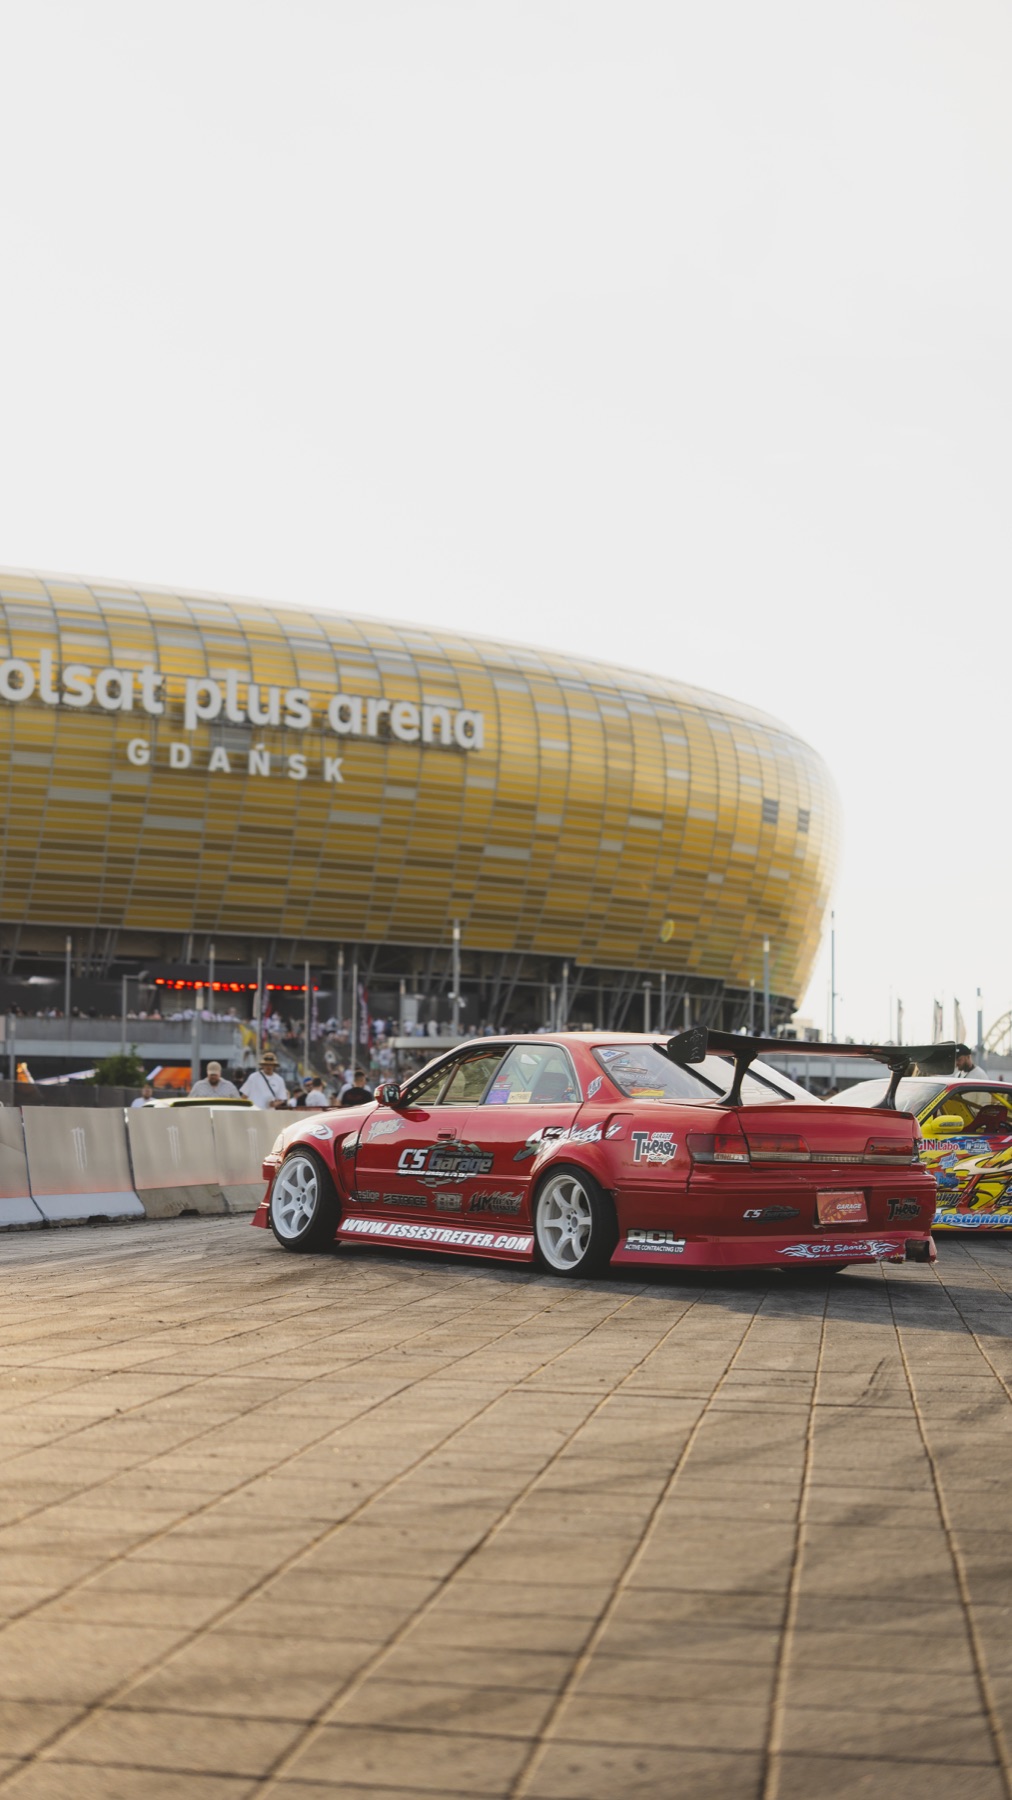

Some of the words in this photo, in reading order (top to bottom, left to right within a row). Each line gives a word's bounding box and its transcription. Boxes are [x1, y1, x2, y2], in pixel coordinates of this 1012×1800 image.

[0, 648, 165, 714] olsat
[184, 669, 312, 730] plus
[328, 691, 485, 750] arena
[126, 738, 345, 783] GDAŃSK
[428, 1149, 493, 1174] Garage
[341, 1218, 532, 1251] WWW.JESSESTREETER.COM
[833, 1243, 868, 1253] Sports
